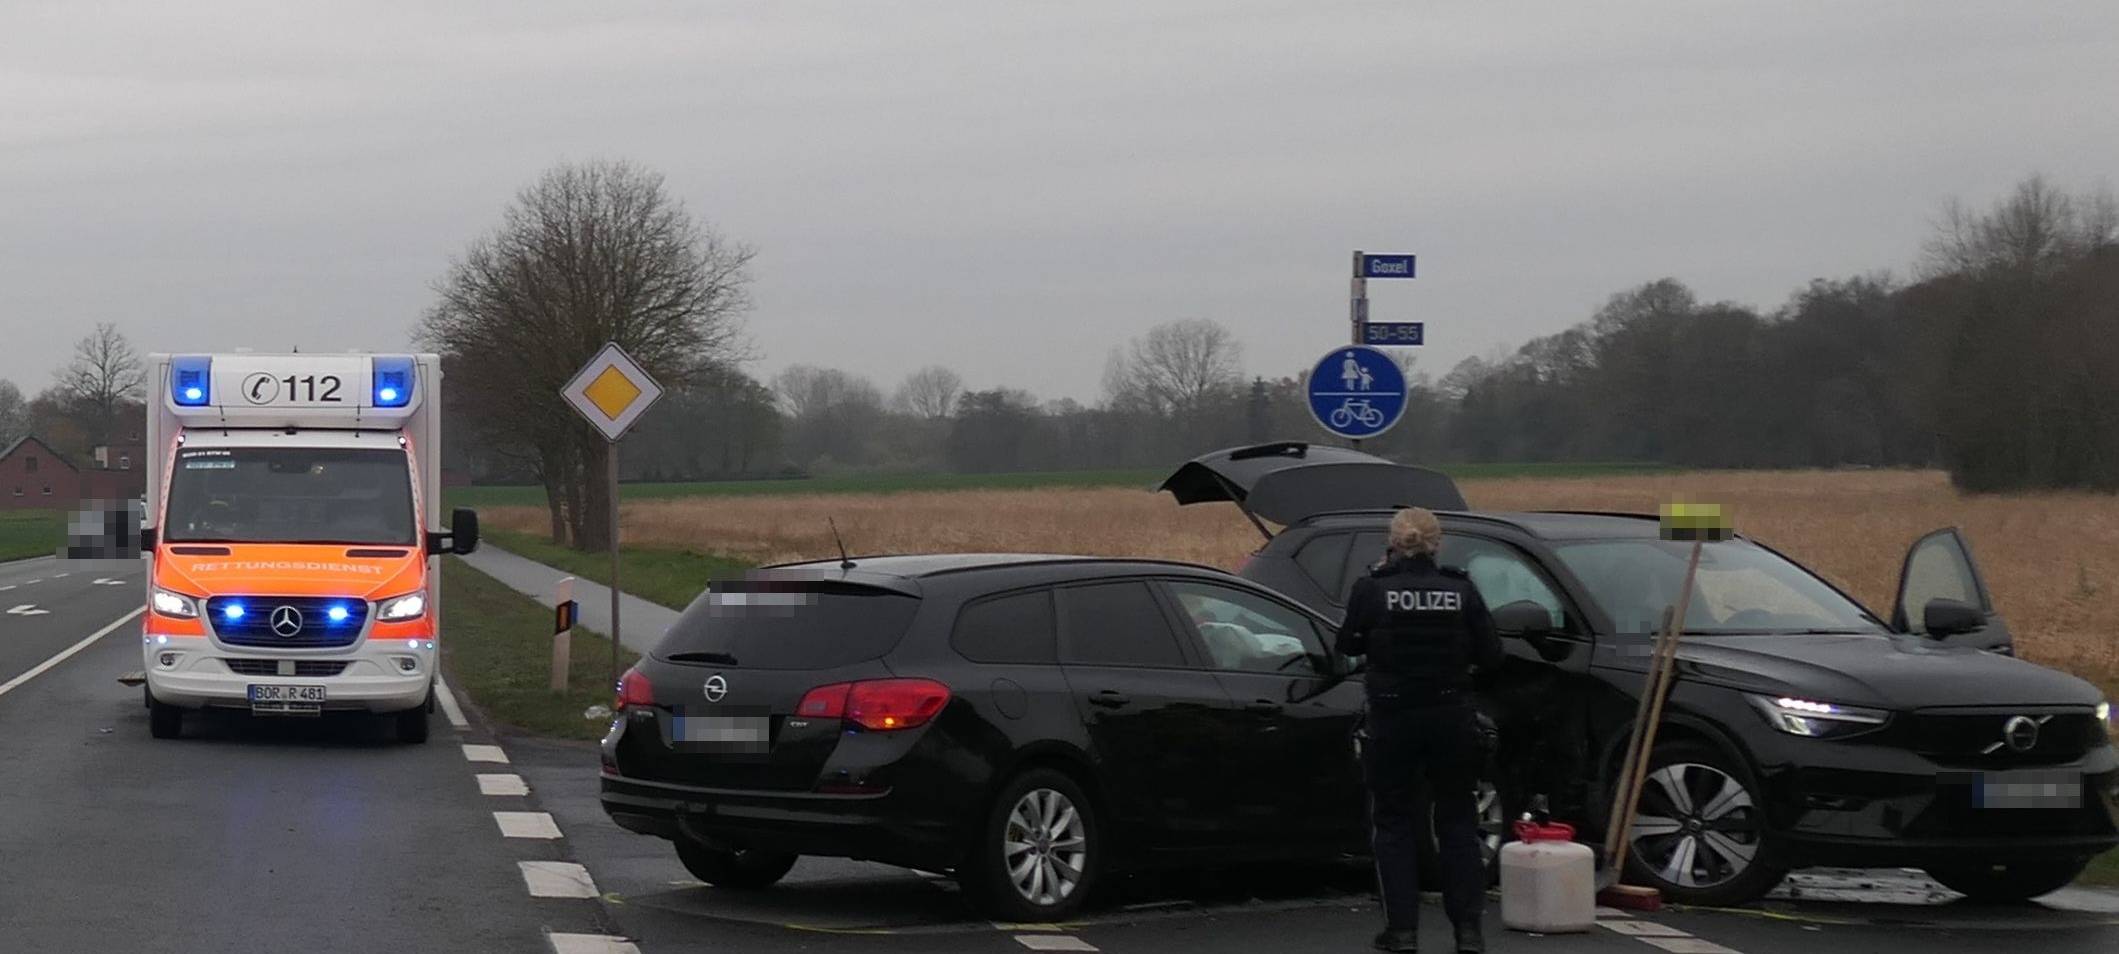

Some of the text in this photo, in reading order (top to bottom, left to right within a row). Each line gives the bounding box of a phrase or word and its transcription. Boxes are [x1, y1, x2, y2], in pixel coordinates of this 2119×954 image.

[282, 375, 342, 402] 112
[192, 561, 383, 575] RETTUNGSDIENST
[1387, 590, 1461, 611] POLIZEI
[256, 687, 280, 699] BOR
[300, 687, 323, 700] 481
